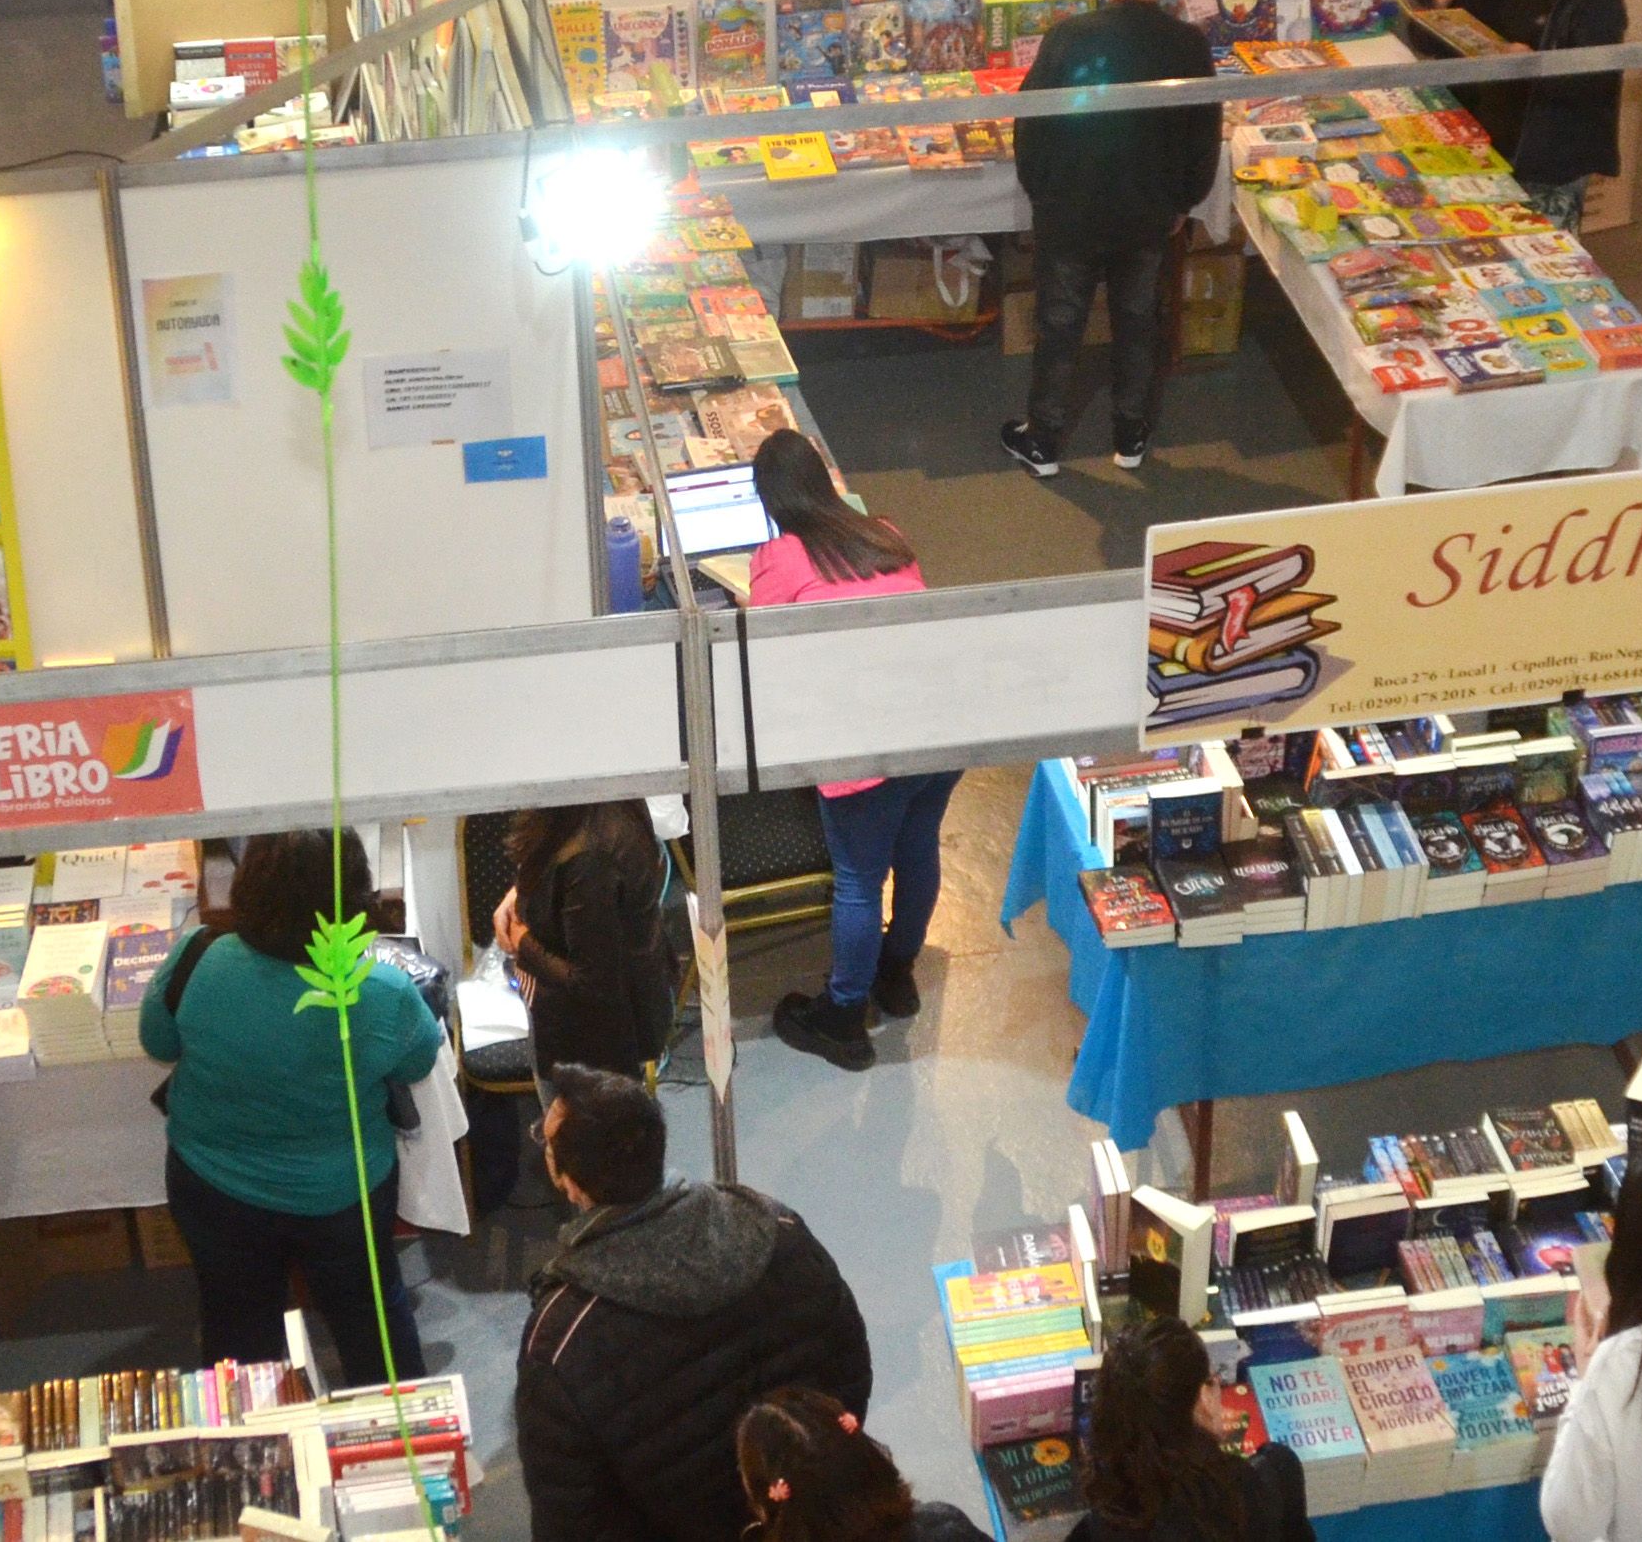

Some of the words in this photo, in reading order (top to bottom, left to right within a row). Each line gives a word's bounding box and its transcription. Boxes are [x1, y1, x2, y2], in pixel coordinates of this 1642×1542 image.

[1374, 673, 1408, 688] Roca
[1512, 654, 1580, 675] Cipolletti
[54, 794, 113, 808] Palabras
[1345, 1354, 1419, 1380] ROMPER
[1269, 1374, 1298, 1393] NO
[1299, 1369, 1327, 1388] TE
[1351, 1378, 1375, 1395] EL
[1287, 1415, 1336, 1431] COLLEEN
[1377, 1409, 1436, 1431] HOOVER
[1276, 1425, 1355, 1449] HOOVER
[1023, 1461, 1072, 1485] OTRAS
